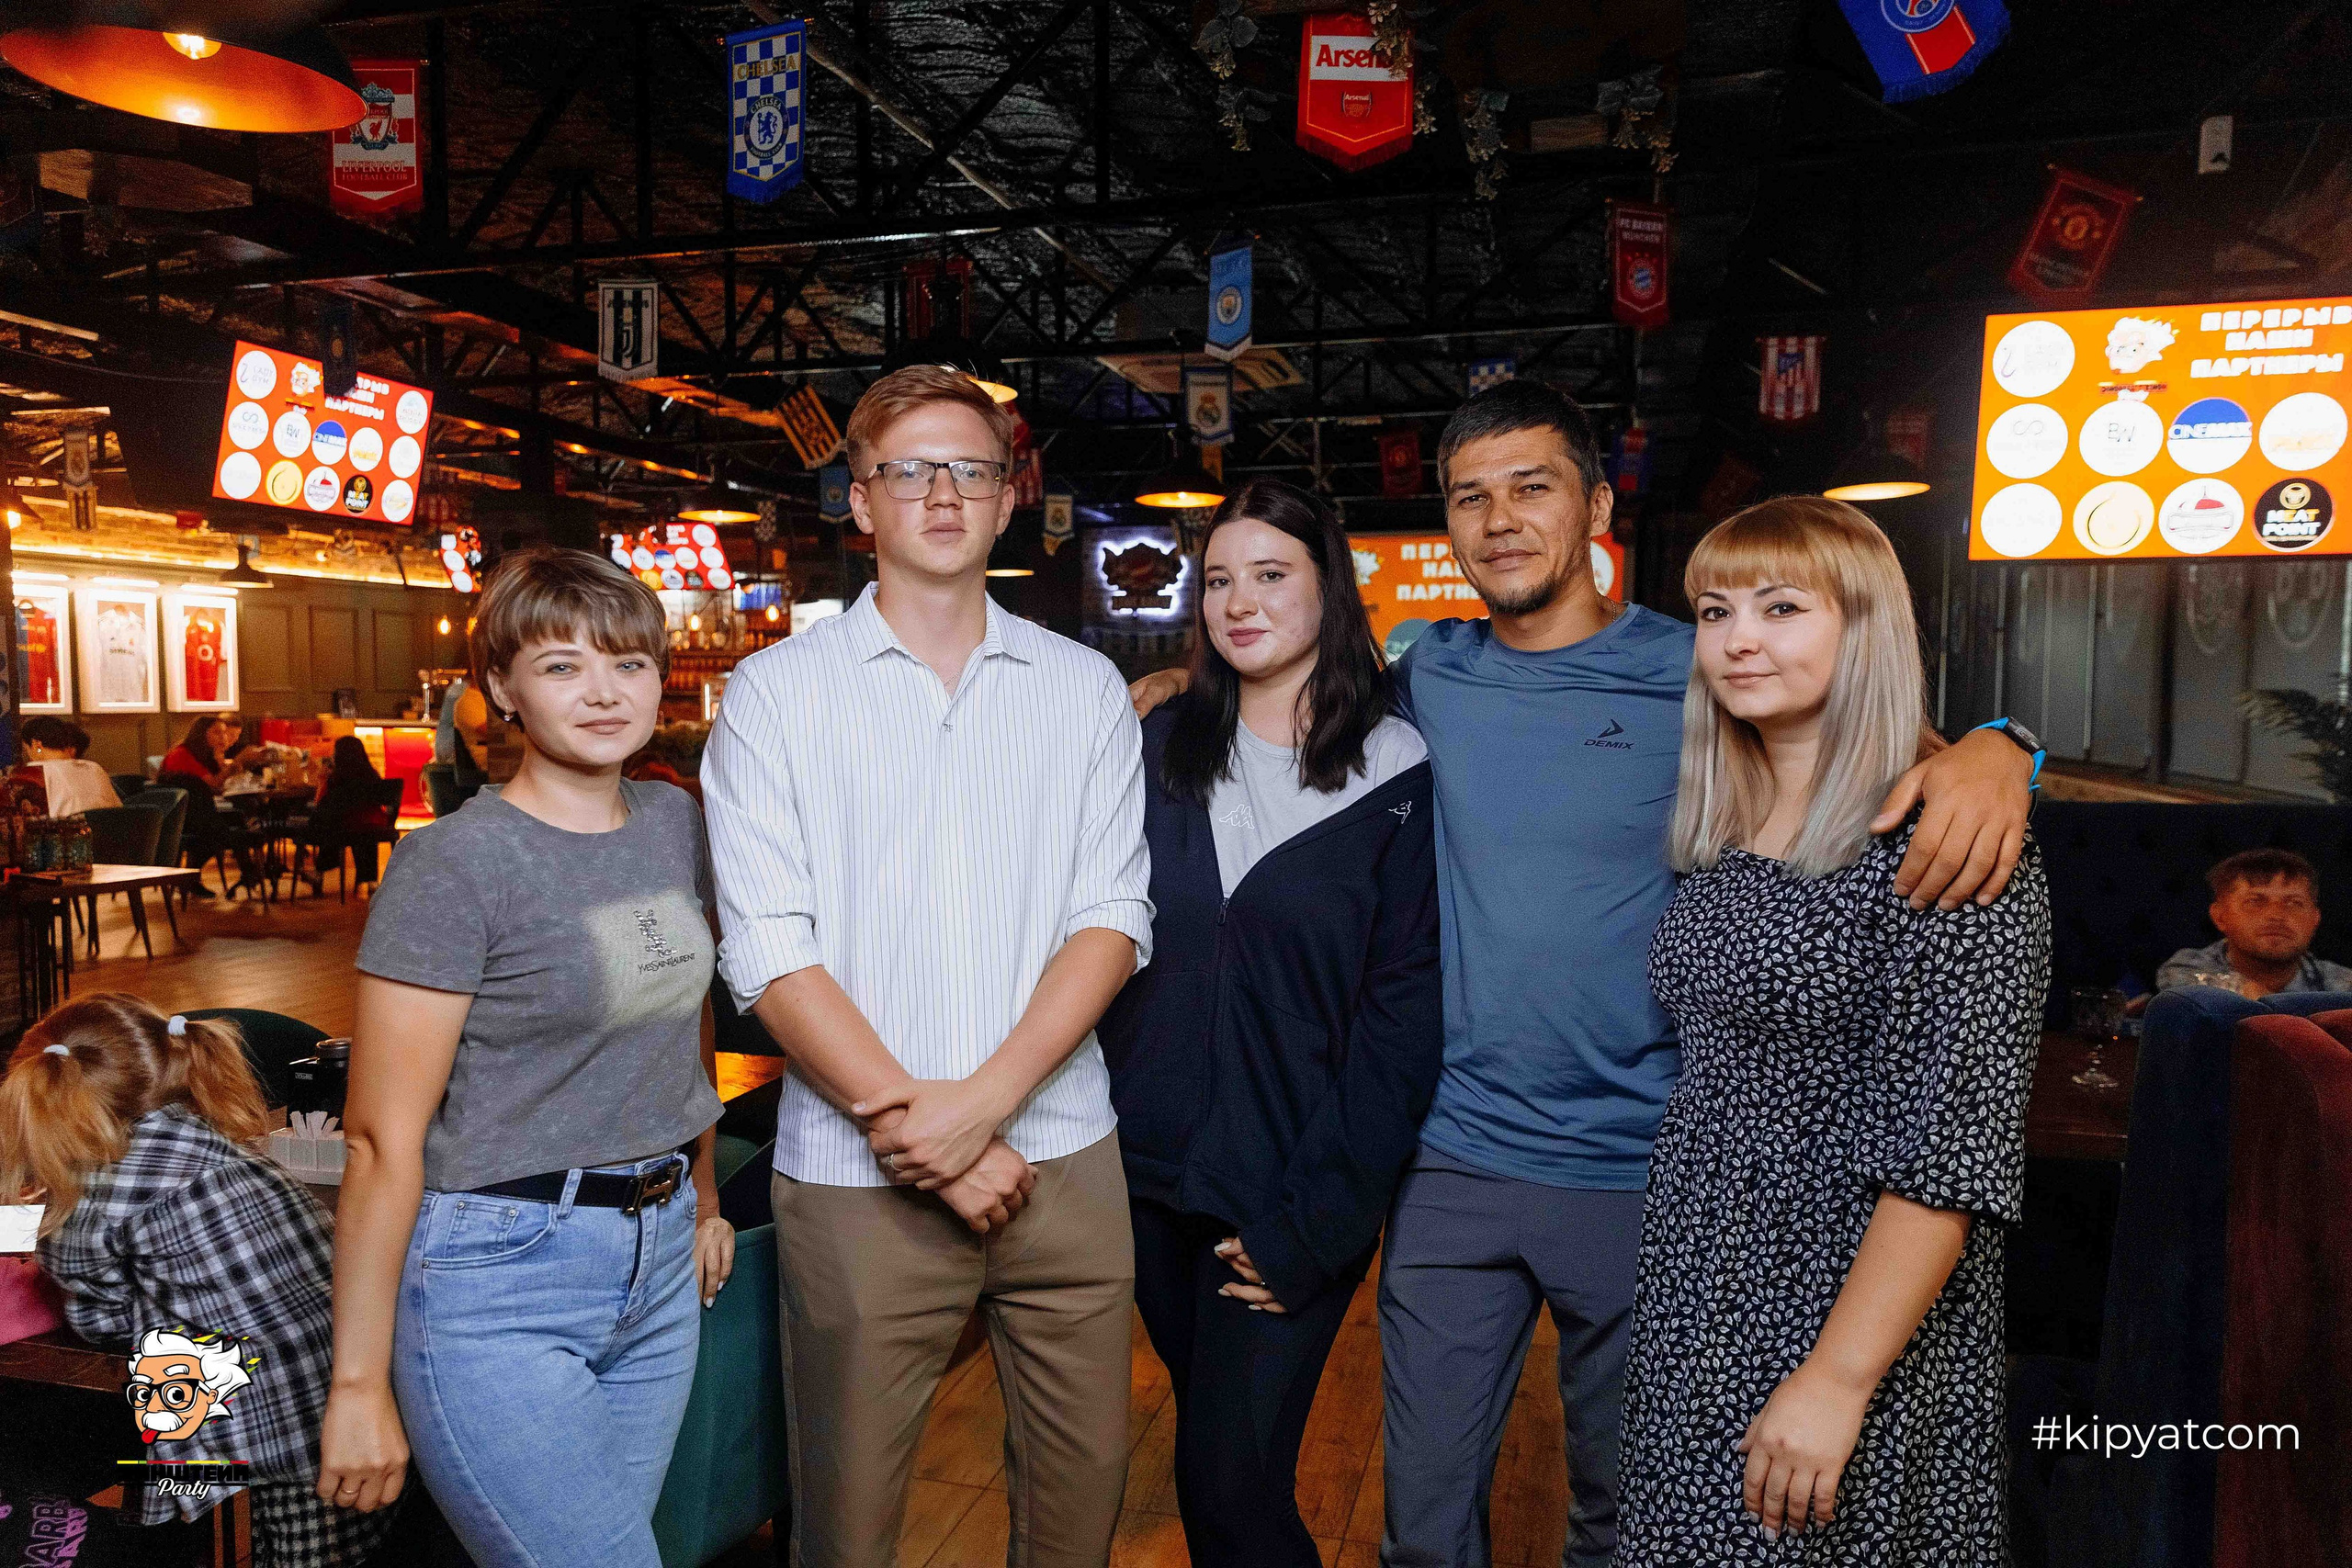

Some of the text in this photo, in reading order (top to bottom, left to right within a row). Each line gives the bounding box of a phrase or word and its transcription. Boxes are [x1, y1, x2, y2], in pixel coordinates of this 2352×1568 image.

[1316, 44, 1394, 69] Arsen
[737, 55, 797, 80] CHELSEA
[751, 97, 782, 114] CHELSEA
[342, 160, 407, 173] LIVERPOOL
[2190, 353, 2345, 378] ПАРТНЕРЫ
[2267, 508, 2320, 524] MEAT
[2262, 521, 2322, 536] POINT
[1583, 739, 1634, 750] DEMIX
